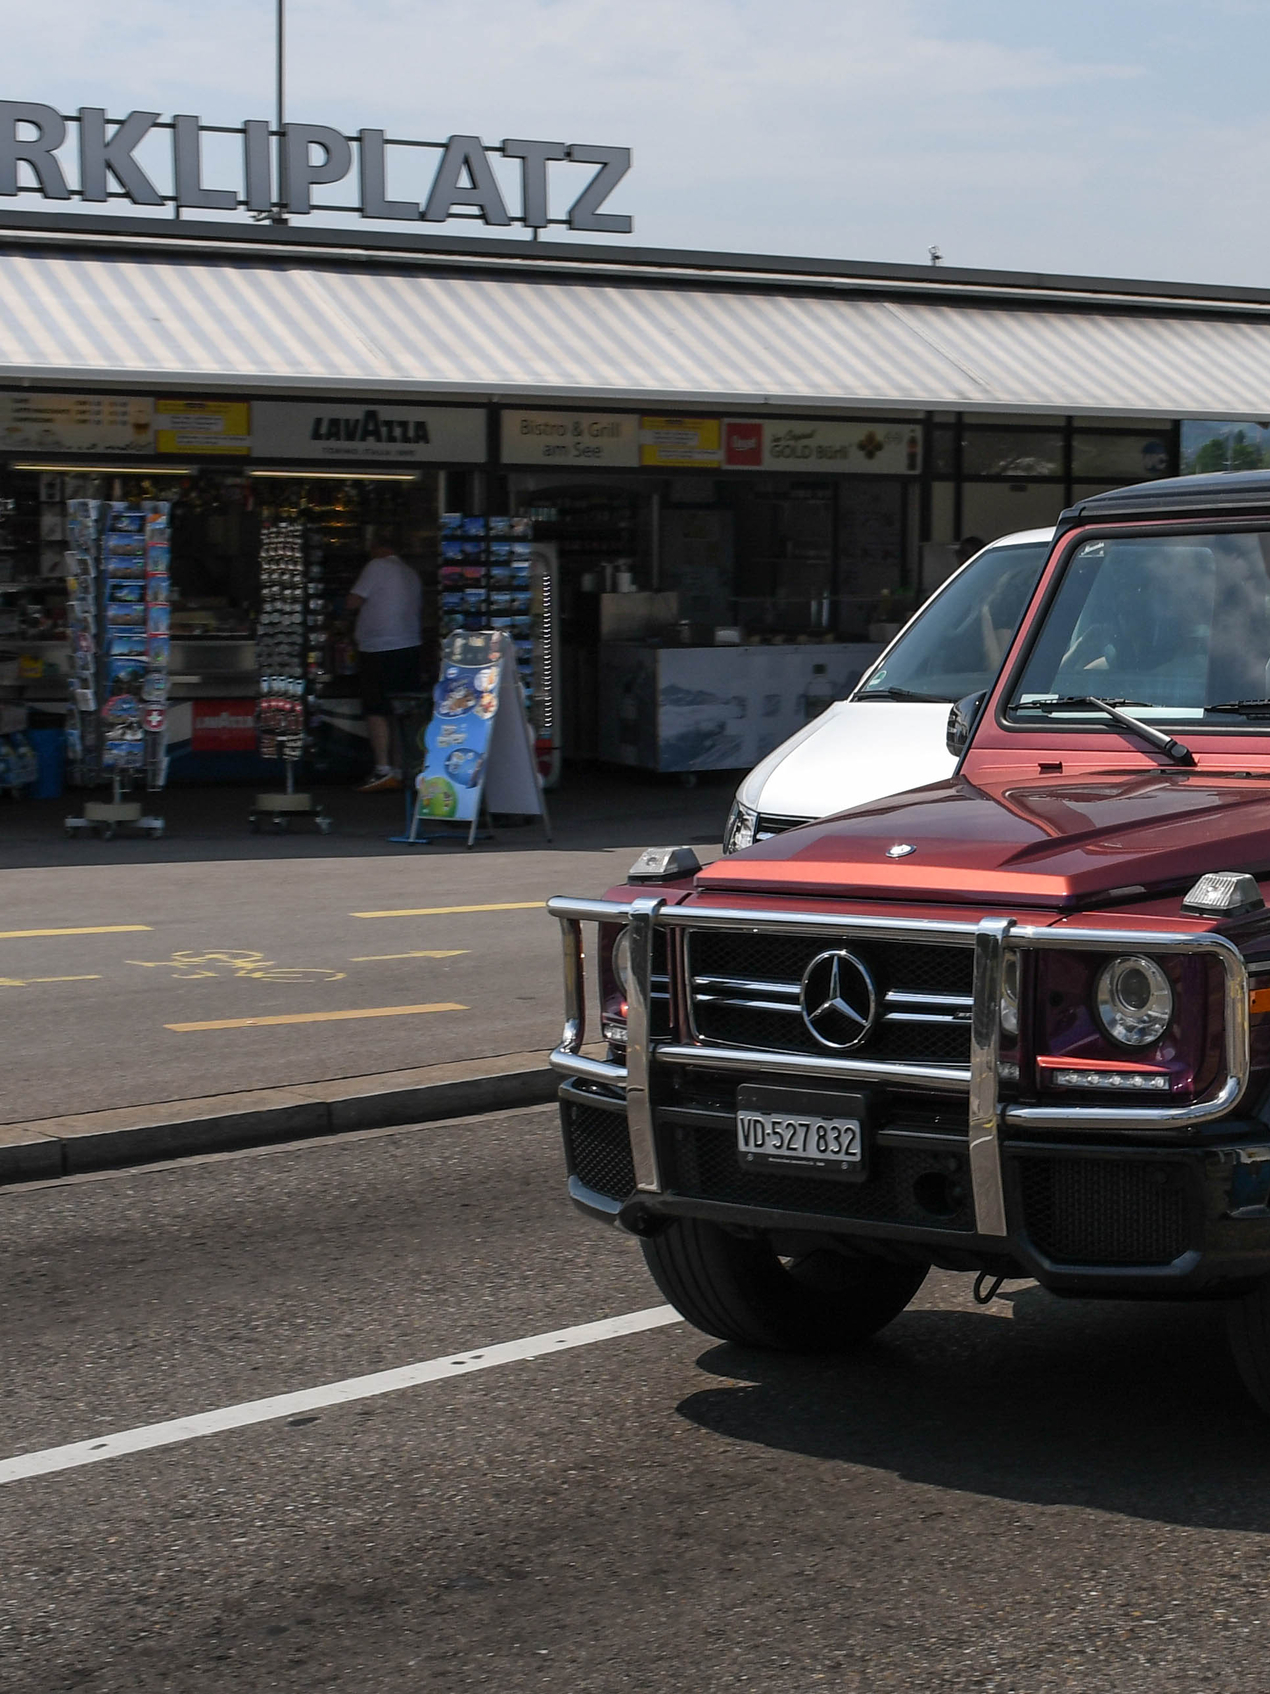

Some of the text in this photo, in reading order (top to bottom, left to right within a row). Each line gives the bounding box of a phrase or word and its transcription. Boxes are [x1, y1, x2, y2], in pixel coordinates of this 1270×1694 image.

[0, 99, 634, 234] RKLIPLATZ
[310, 410, 430, 445] LAVAZZA
[520, 418, 621, 438] Bistro & Grill
[542, 441, 604, 459] am See
